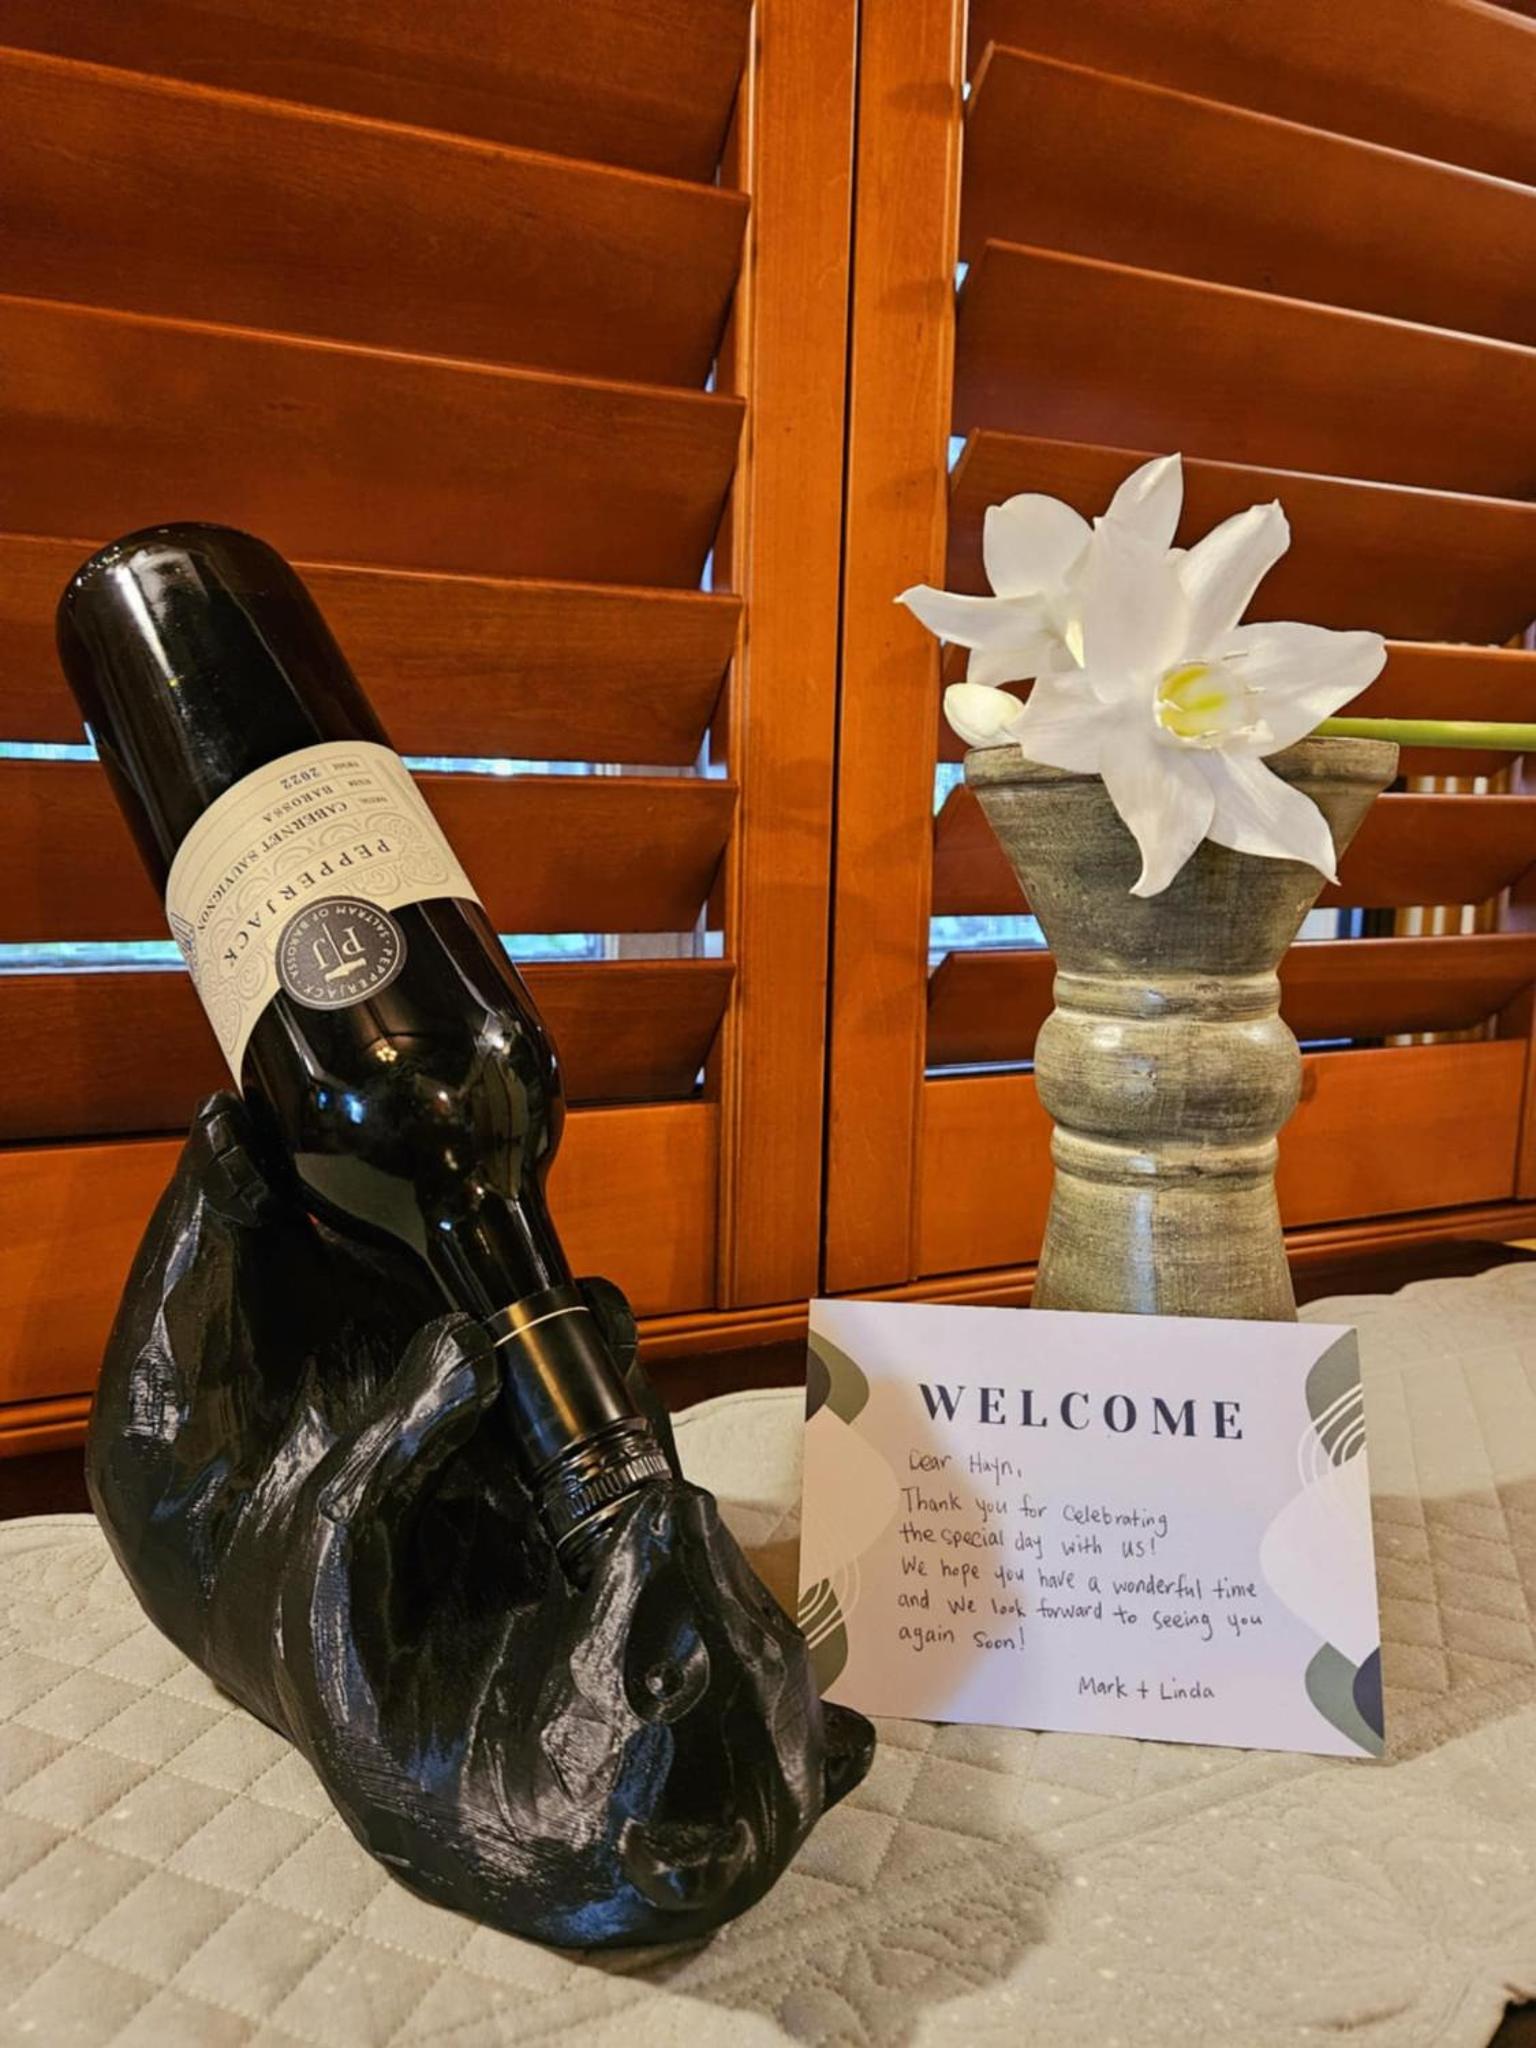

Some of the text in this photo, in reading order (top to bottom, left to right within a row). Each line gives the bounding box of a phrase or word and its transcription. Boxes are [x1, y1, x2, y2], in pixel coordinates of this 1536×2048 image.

[281, 765, 323, 790] 2022
[262, 784, 335, 822] BAROSSA
[197, 801, 348, 935] CABERNET SAUVIGNON
[223, 838, 392, 963] PEPPERJACK
[311, 907, 330, 920] OF
[335, 905, 390, 939] SALTRAM
[303, 948, 394, 999] PEPPERJACK
[918, 1383, 1244, 1440] WELCOME
[908, 1449, 953, 1472] Dear
[900, 1486, 963, 1513] Thank
[975, 1497, 1008, 1523] you
[1017, 1493, 1048, 1518] for
[899, 1521, 938, 1544] the
[1015, 1530, 1044, 1560] day
[1061, 1534, 1103, 1557] with
[1122, 1536, 1156, 1558] us!
[901, 1555, 1257, 1601] We hope you have a wonderful time
[897, 1588, 930, 1610] and
[991, 1598, 1027, 1618] look
[1036, 1598, 1103, 1620] forward
[1112, 1604, 1138, 1626] to
[1226, 1613, 1263, 1638] you
[898, 1623, 956, 1652] again
[1078, 1675, 1216, 1700] Mark + Linda
